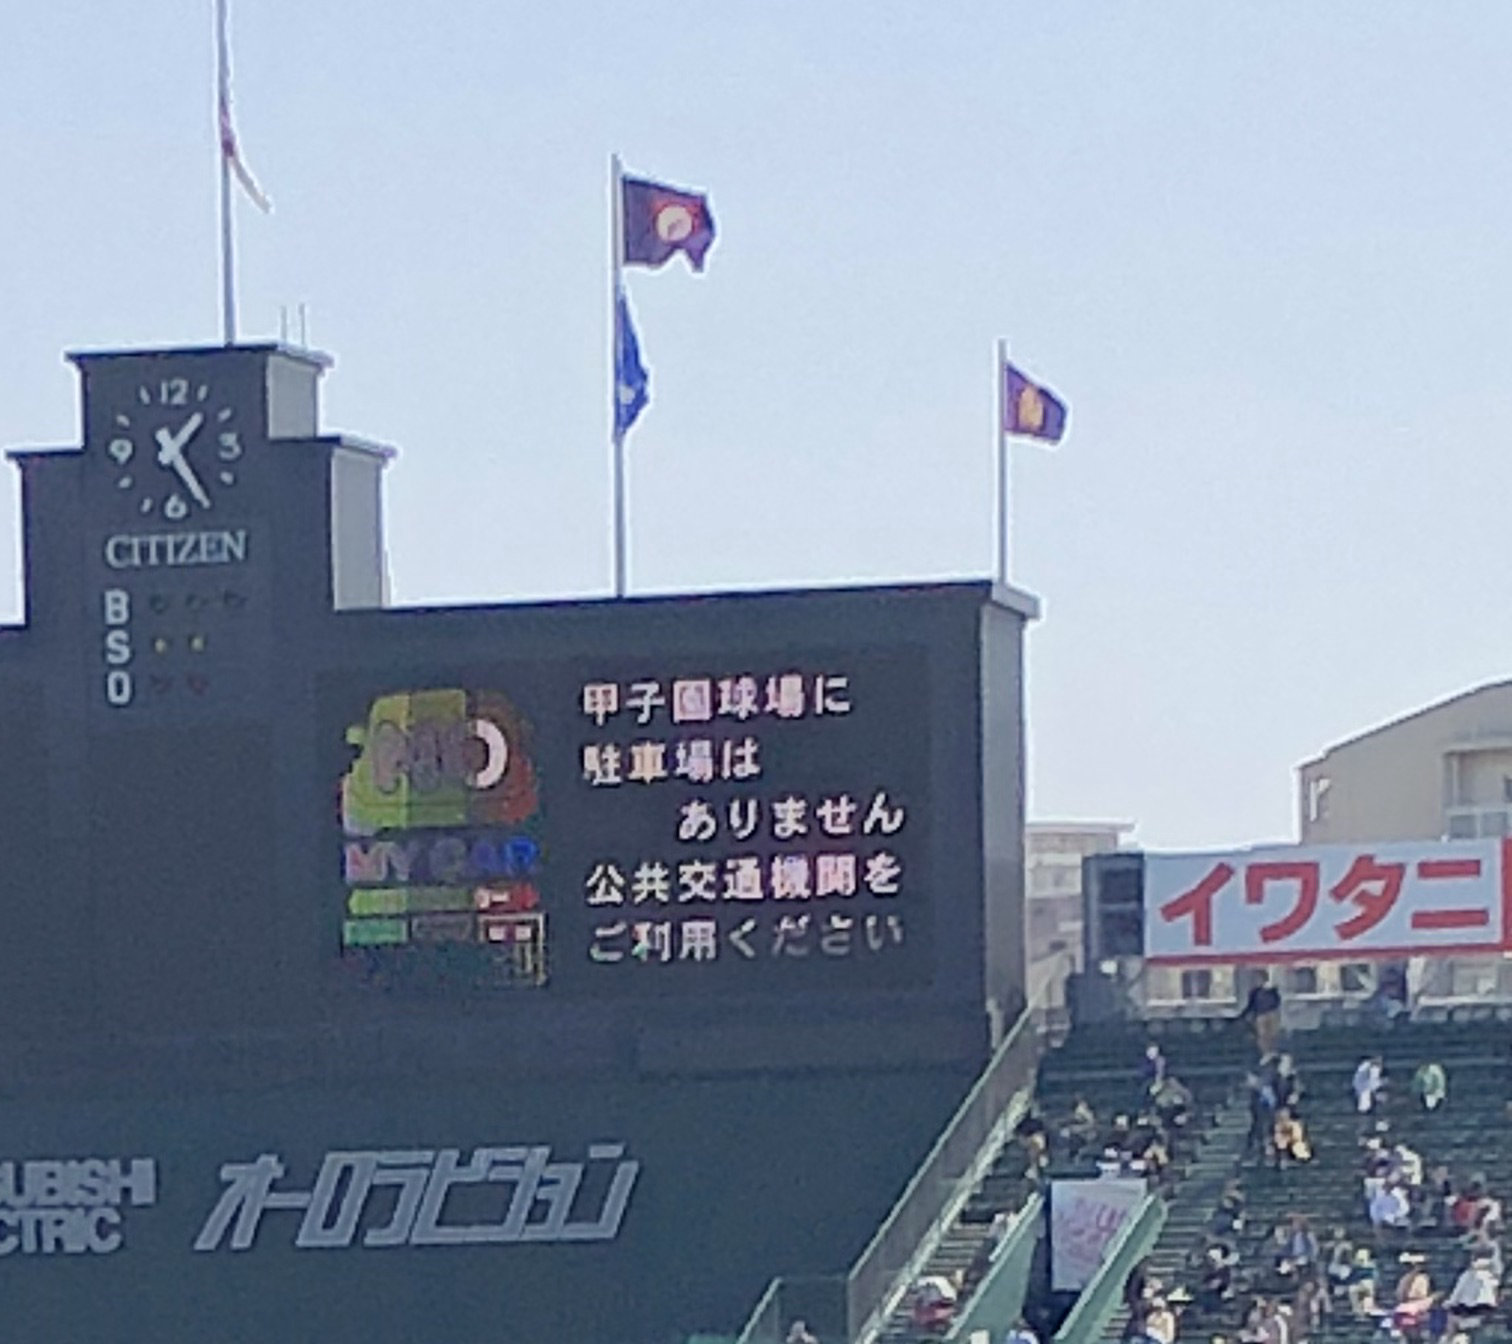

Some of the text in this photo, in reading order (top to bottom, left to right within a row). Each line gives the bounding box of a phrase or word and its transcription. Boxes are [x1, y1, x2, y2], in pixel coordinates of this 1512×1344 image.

[161, 379, 187, 405] 12
[109, 440, 133, 463] 9
[218, 433, 242, 459] 3
[165, 495, 187, 518] 6
[106, 530, 248, 569] CITIZEN
[105, 590, 130, 625] B
[106, 630, 131, 664] S
[583, 674, 851, 726] 甲子園球場に
[583, 737, 761, 786] 駐車場は
[678, 793, 904, 840] ありません
[1160, 854, 1489, 946] イワタニ
[590, 915, 903, 962] ご利用ください
